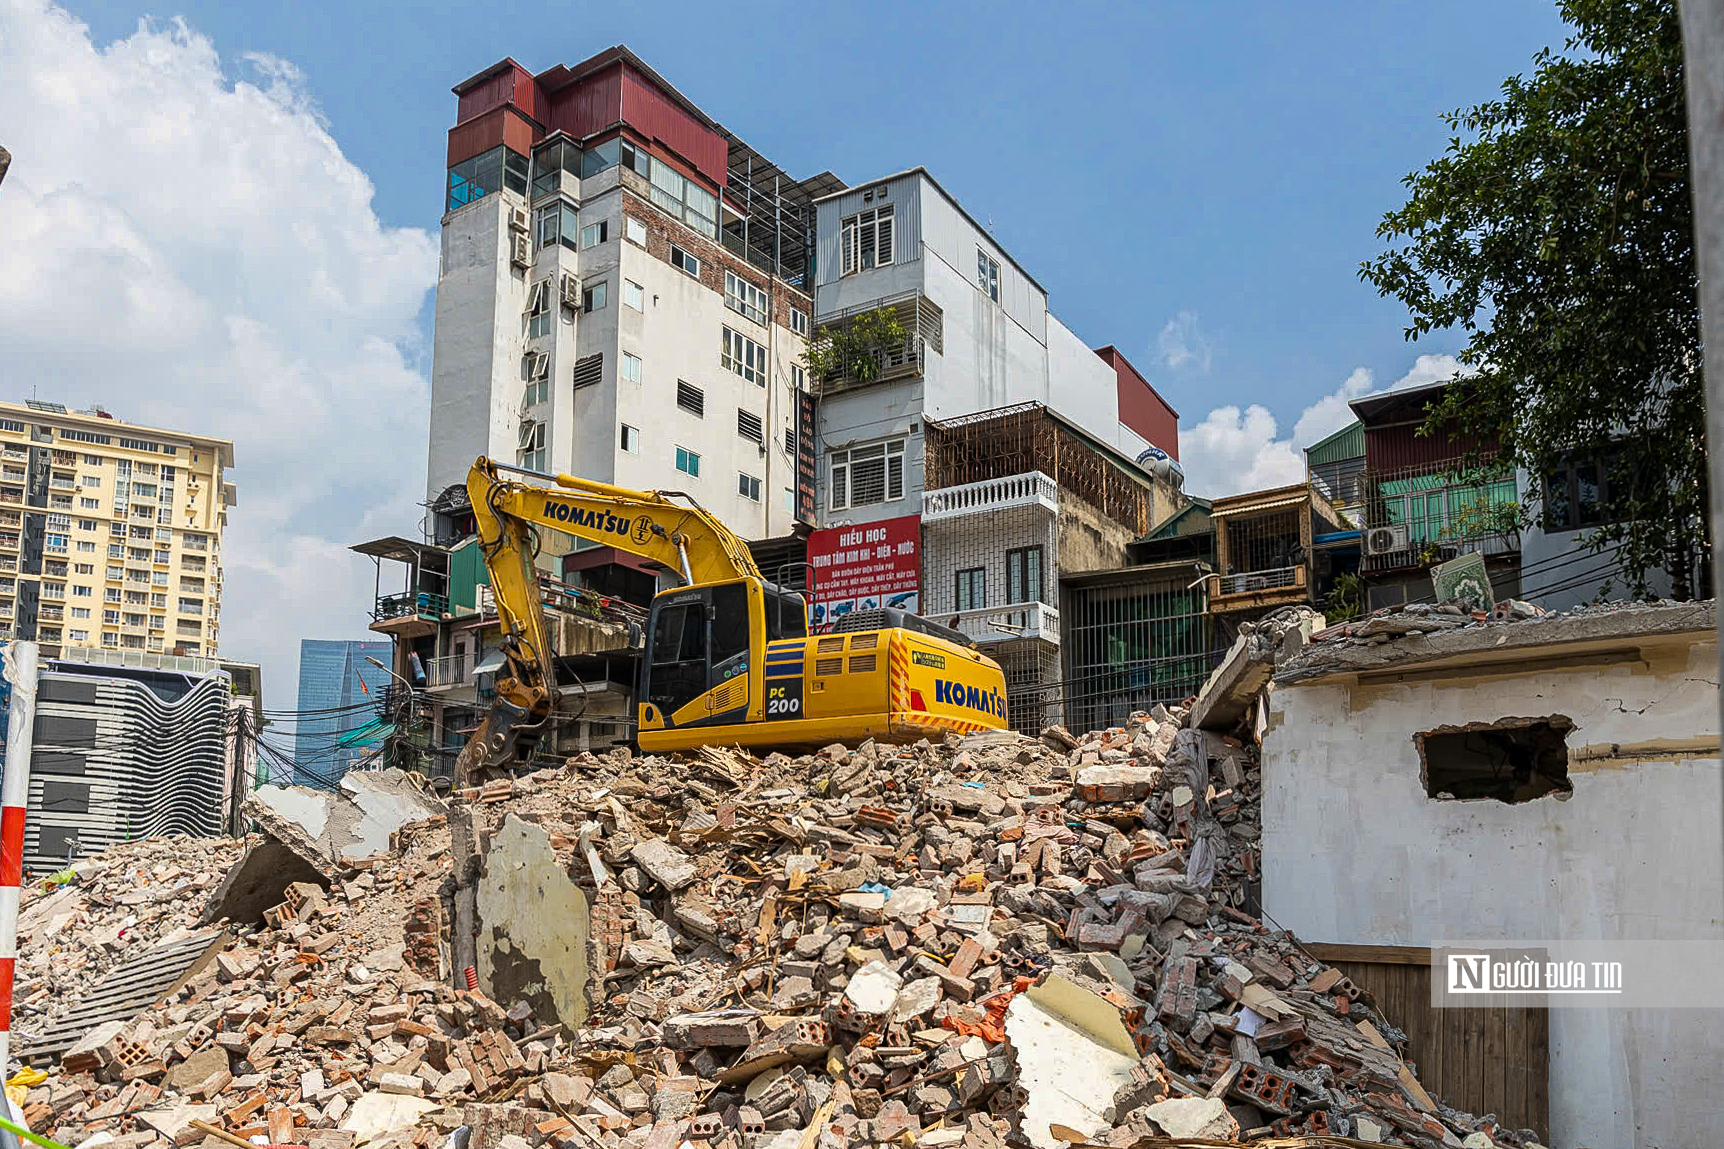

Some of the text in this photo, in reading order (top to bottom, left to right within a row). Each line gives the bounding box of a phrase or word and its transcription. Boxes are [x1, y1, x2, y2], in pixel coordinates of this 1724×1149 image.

[543, 500, 631, 536] KOMATSU
[840, 527, 887, 547] HIẾU HỌC
[813, 554, 832, 568] TRUNG
[769, 687, 785, 698] PC
[935, 679, 1006, 721] KOMATSU
[768, 698, 799, 713] 200
